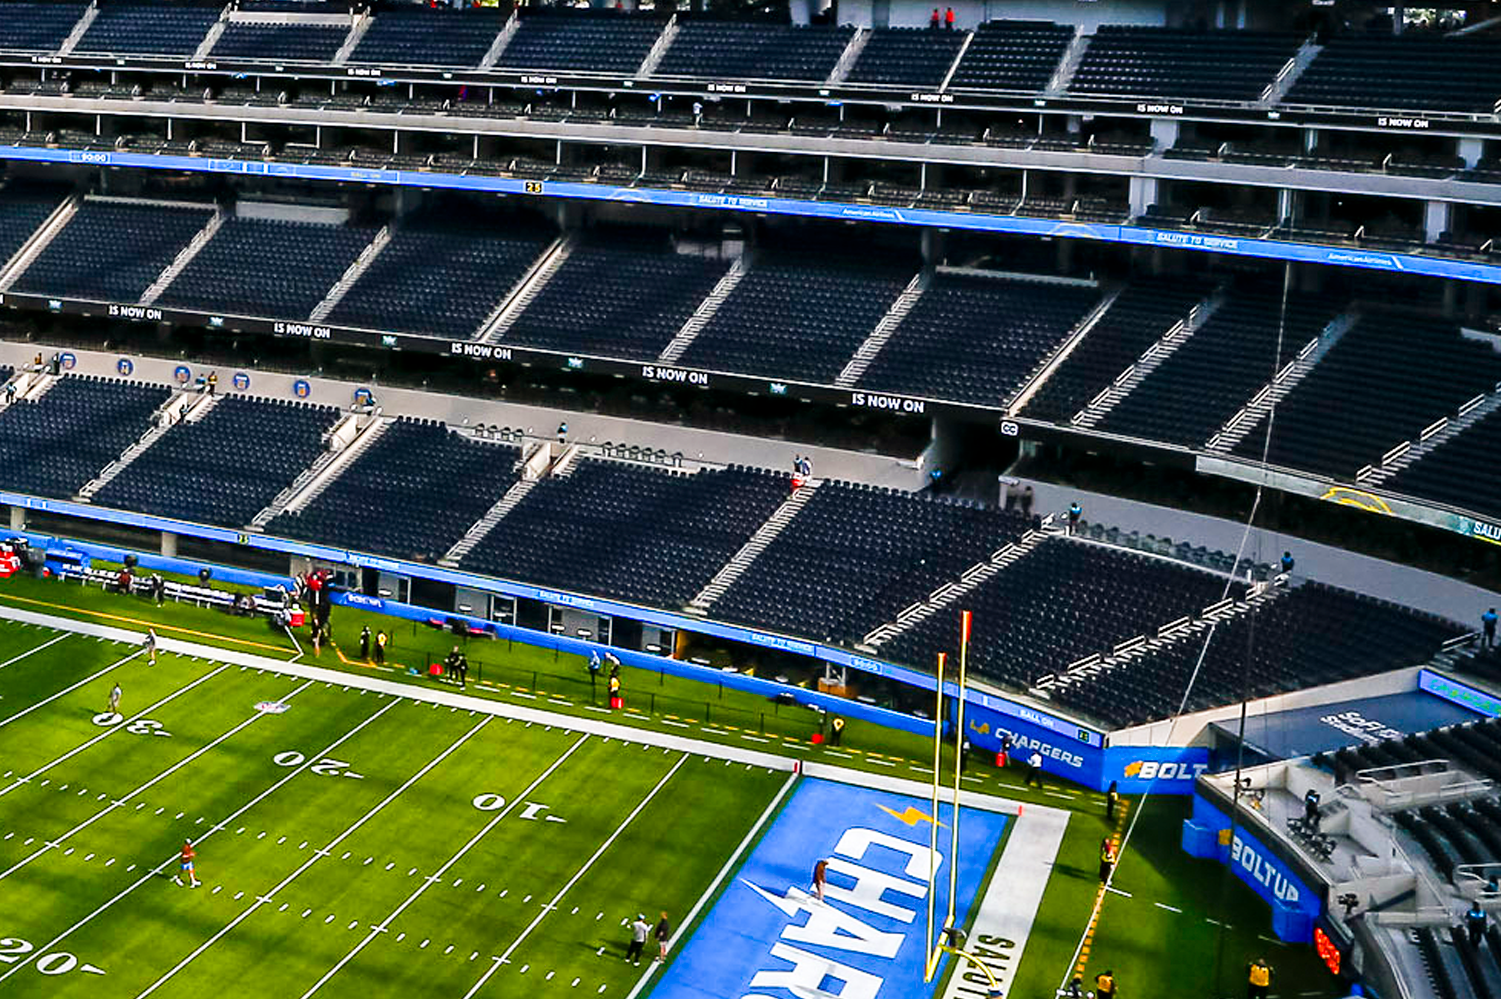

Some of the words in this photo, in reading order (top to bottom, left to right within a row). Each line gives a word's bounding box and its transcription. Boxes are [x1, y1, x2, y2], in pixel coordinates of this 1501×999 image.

[1137, 103, 1146, 112] IS
[1147, 104, 1169, 113] NOW
[1170, 106, 1183, 114] ON
[1378, 117, 1387, 127] IS
[1388, 118, 1412, 128] NOW
[1413, 119, 1428, 128] ON
[1156, 232, 1188, 245] SALUTE
[1189, 235, 1201, 245] TO
[1203, 237, 1238, 249] SERVICE
[108, 305, 119, 315] IS
[120, 306, 145, 319] NOW
[146, 309, 162, 320] ON
[274, 322, 284, 333] IS
[286, 323, 313, 337] NOW
[314, 326, 330, 338] ON
[451, 343, 462, 354] IS
[464, 345, 492, 358] NOW
[494, 347, 512, 360] ON
[642, 366, 655, 378] IS
[656, 367, 686, 382] NOW
[687, 371, 709, 385] ON
[852, 393, 865, 406] IS
[867, 394, 901, 411] NOW
[903, 399, 925, 413] ON
[1002, 422, 1019, 436] CC
[1019, 710, 1040, 723] BALL
[1041, 716, 1055, 727] ON
[994, 727, 1085, 769] CHARGERS
[1138, 761, 1208, 780] BOLT
[1231, 837, 1299, 902] BOLTUP
[739, 827, 944, 999] CHAR
